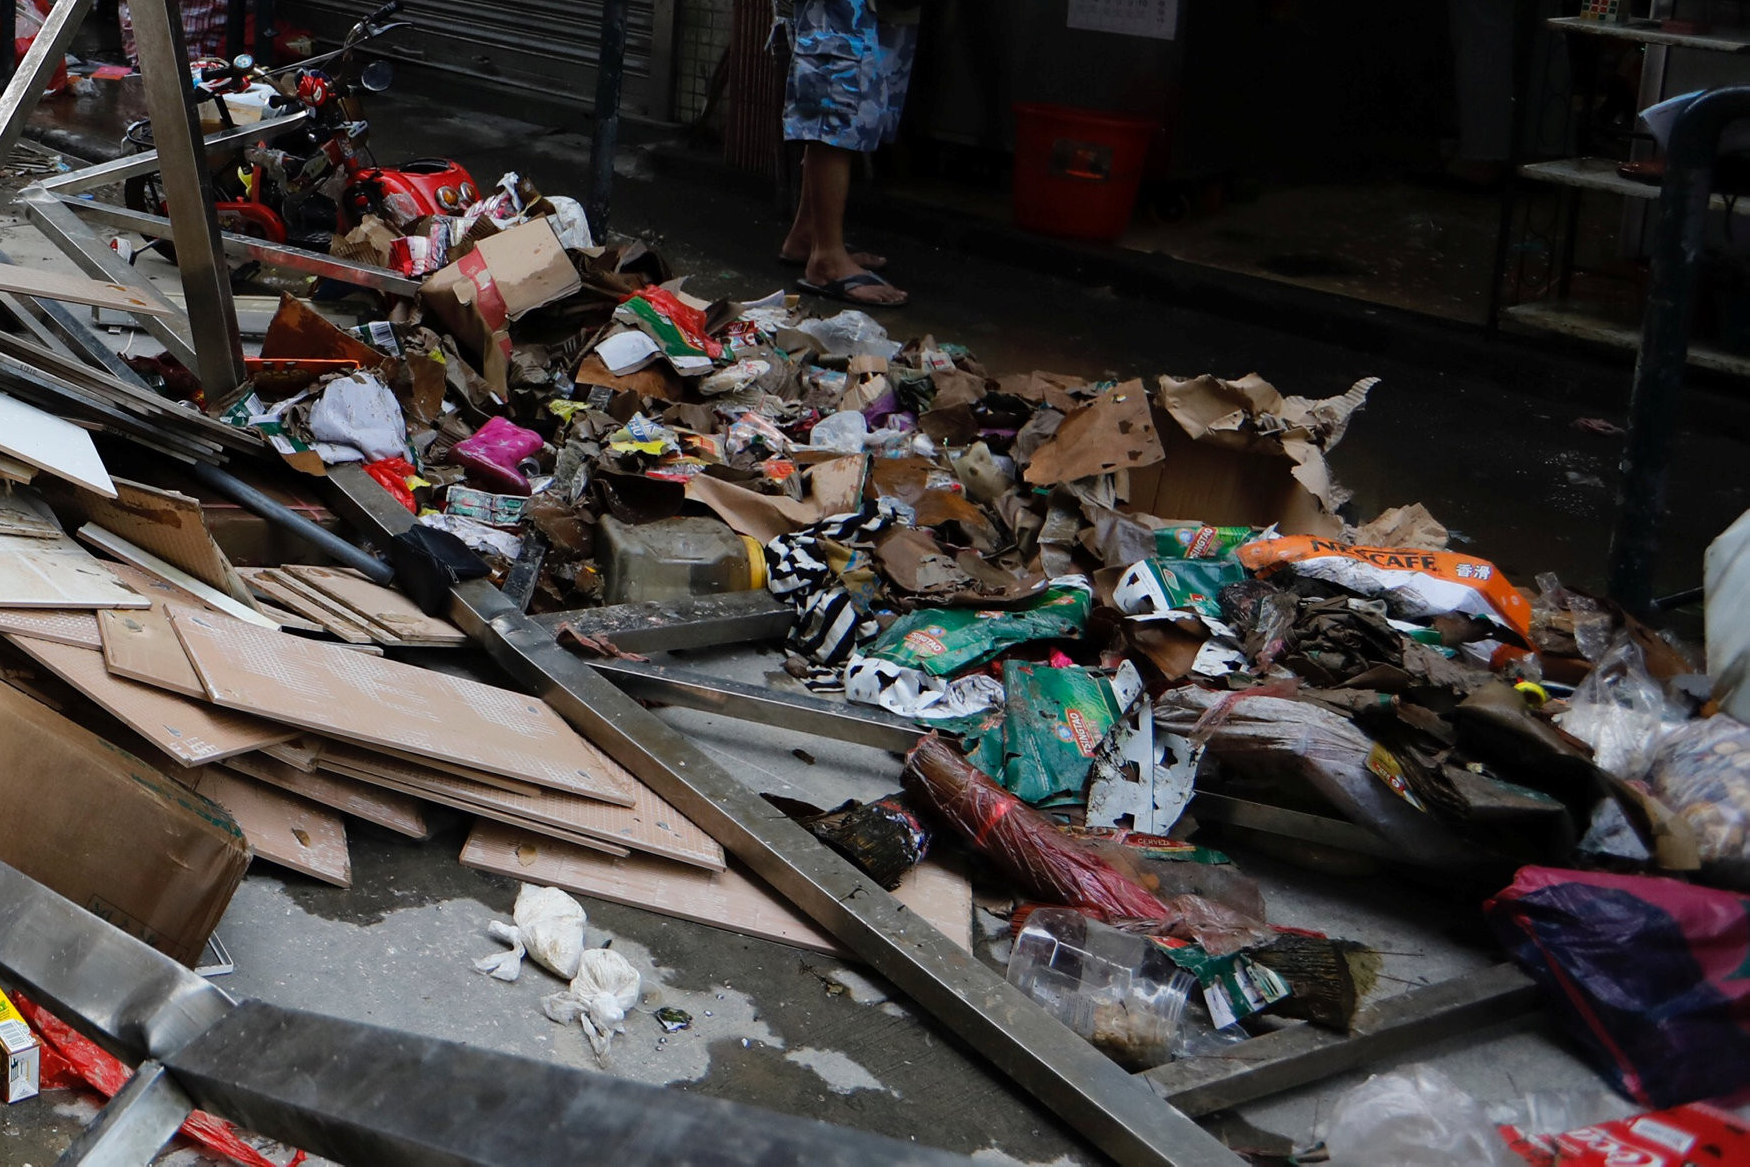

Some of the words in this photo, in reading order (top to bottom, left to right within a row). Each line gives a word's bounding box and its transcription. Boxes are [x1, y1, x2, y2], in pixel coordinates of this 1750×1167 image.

[1189, 527, 1213, 559] SINGTAO
[1455, 563, 1491, 581] 香滑
[1069, 712, 1092, 754] TSINGTAO
[1137, 837, 1171, 846] CERVEZA
